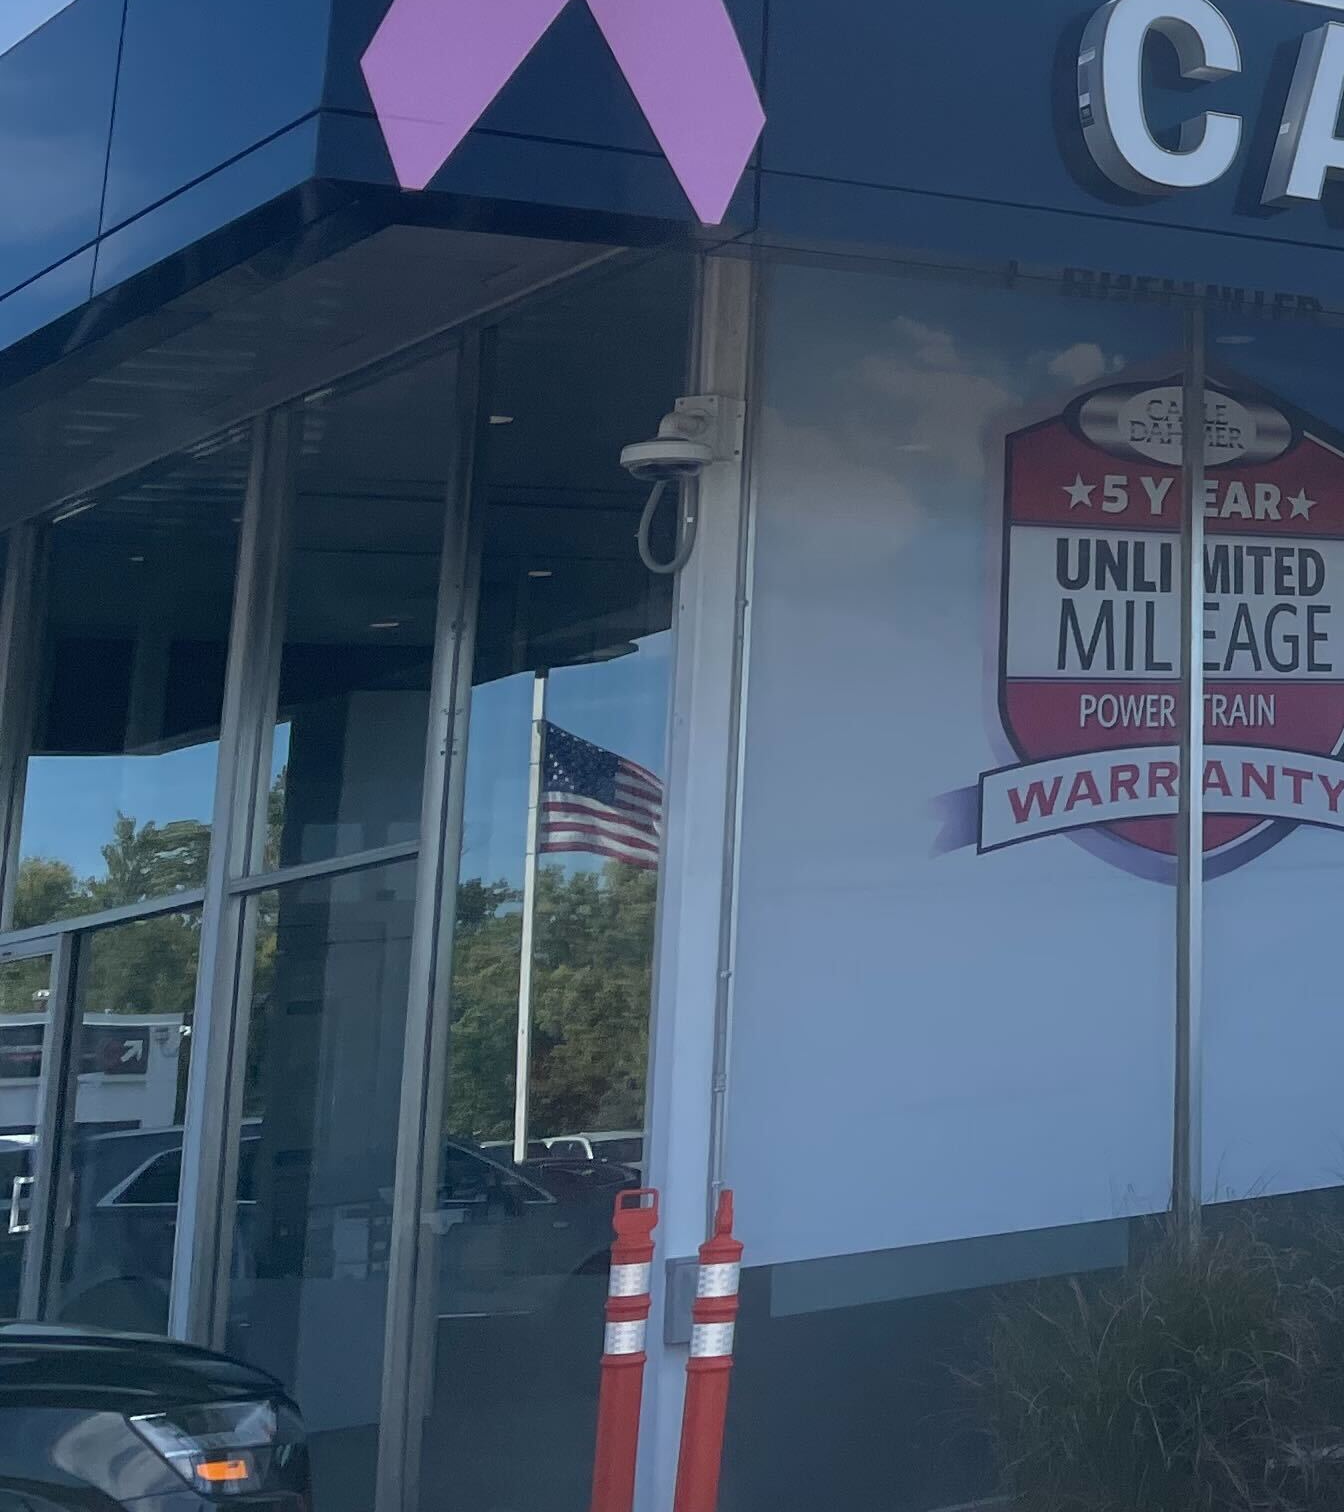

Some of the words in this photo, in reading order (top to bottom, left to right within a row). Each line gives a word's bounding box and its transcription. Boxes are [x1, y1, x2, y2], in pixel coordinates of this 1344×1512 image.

[1146, 399, 1228, 425] CALE
[1102, 475, 1128, 513] 5
[1140, 476, 1282, 520] YEAR
[1056, 538, 1326, 596] UNLIMITED
[1057, 598, 1333, 673] MILEAGE
